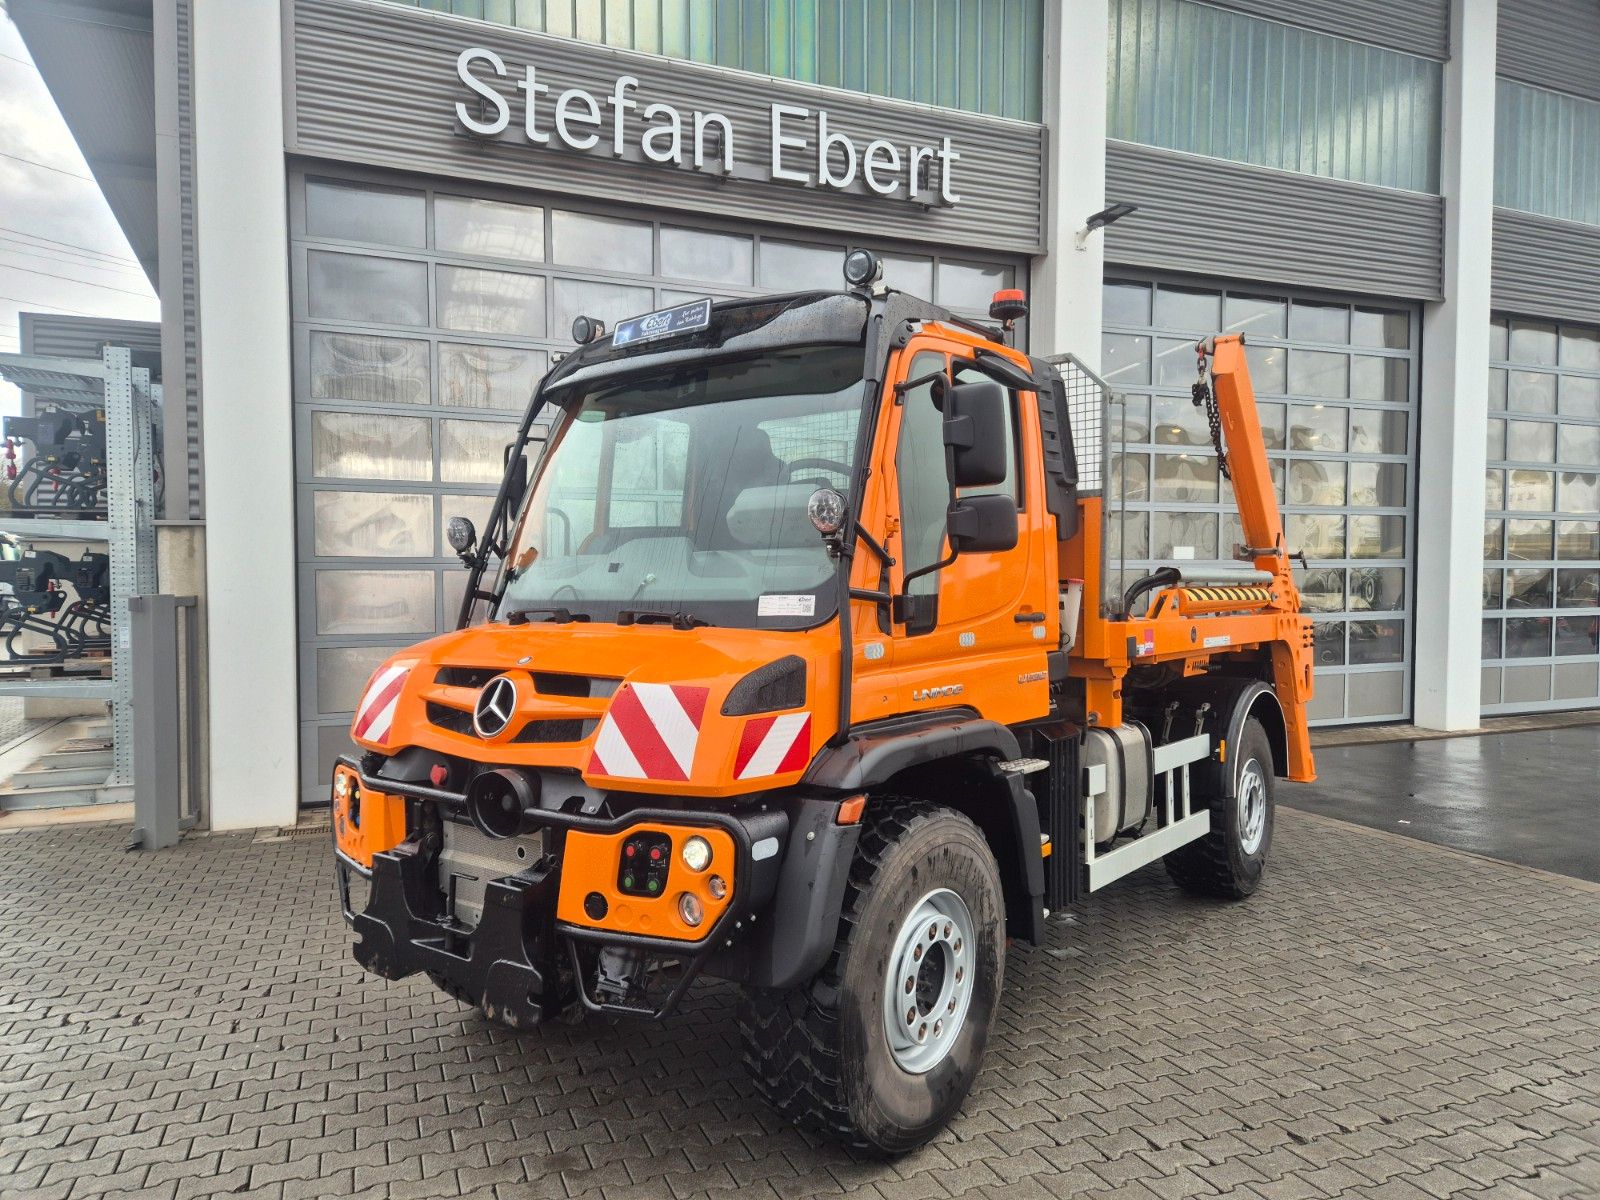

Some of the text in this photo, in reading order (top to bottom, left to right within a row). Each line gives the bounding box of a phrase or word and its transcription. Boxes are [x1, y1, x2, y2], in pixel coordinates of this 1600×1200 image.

[455, 47, 961, 206] Stefan Ebert
[912, 683, 964, 702] UNIMOG
